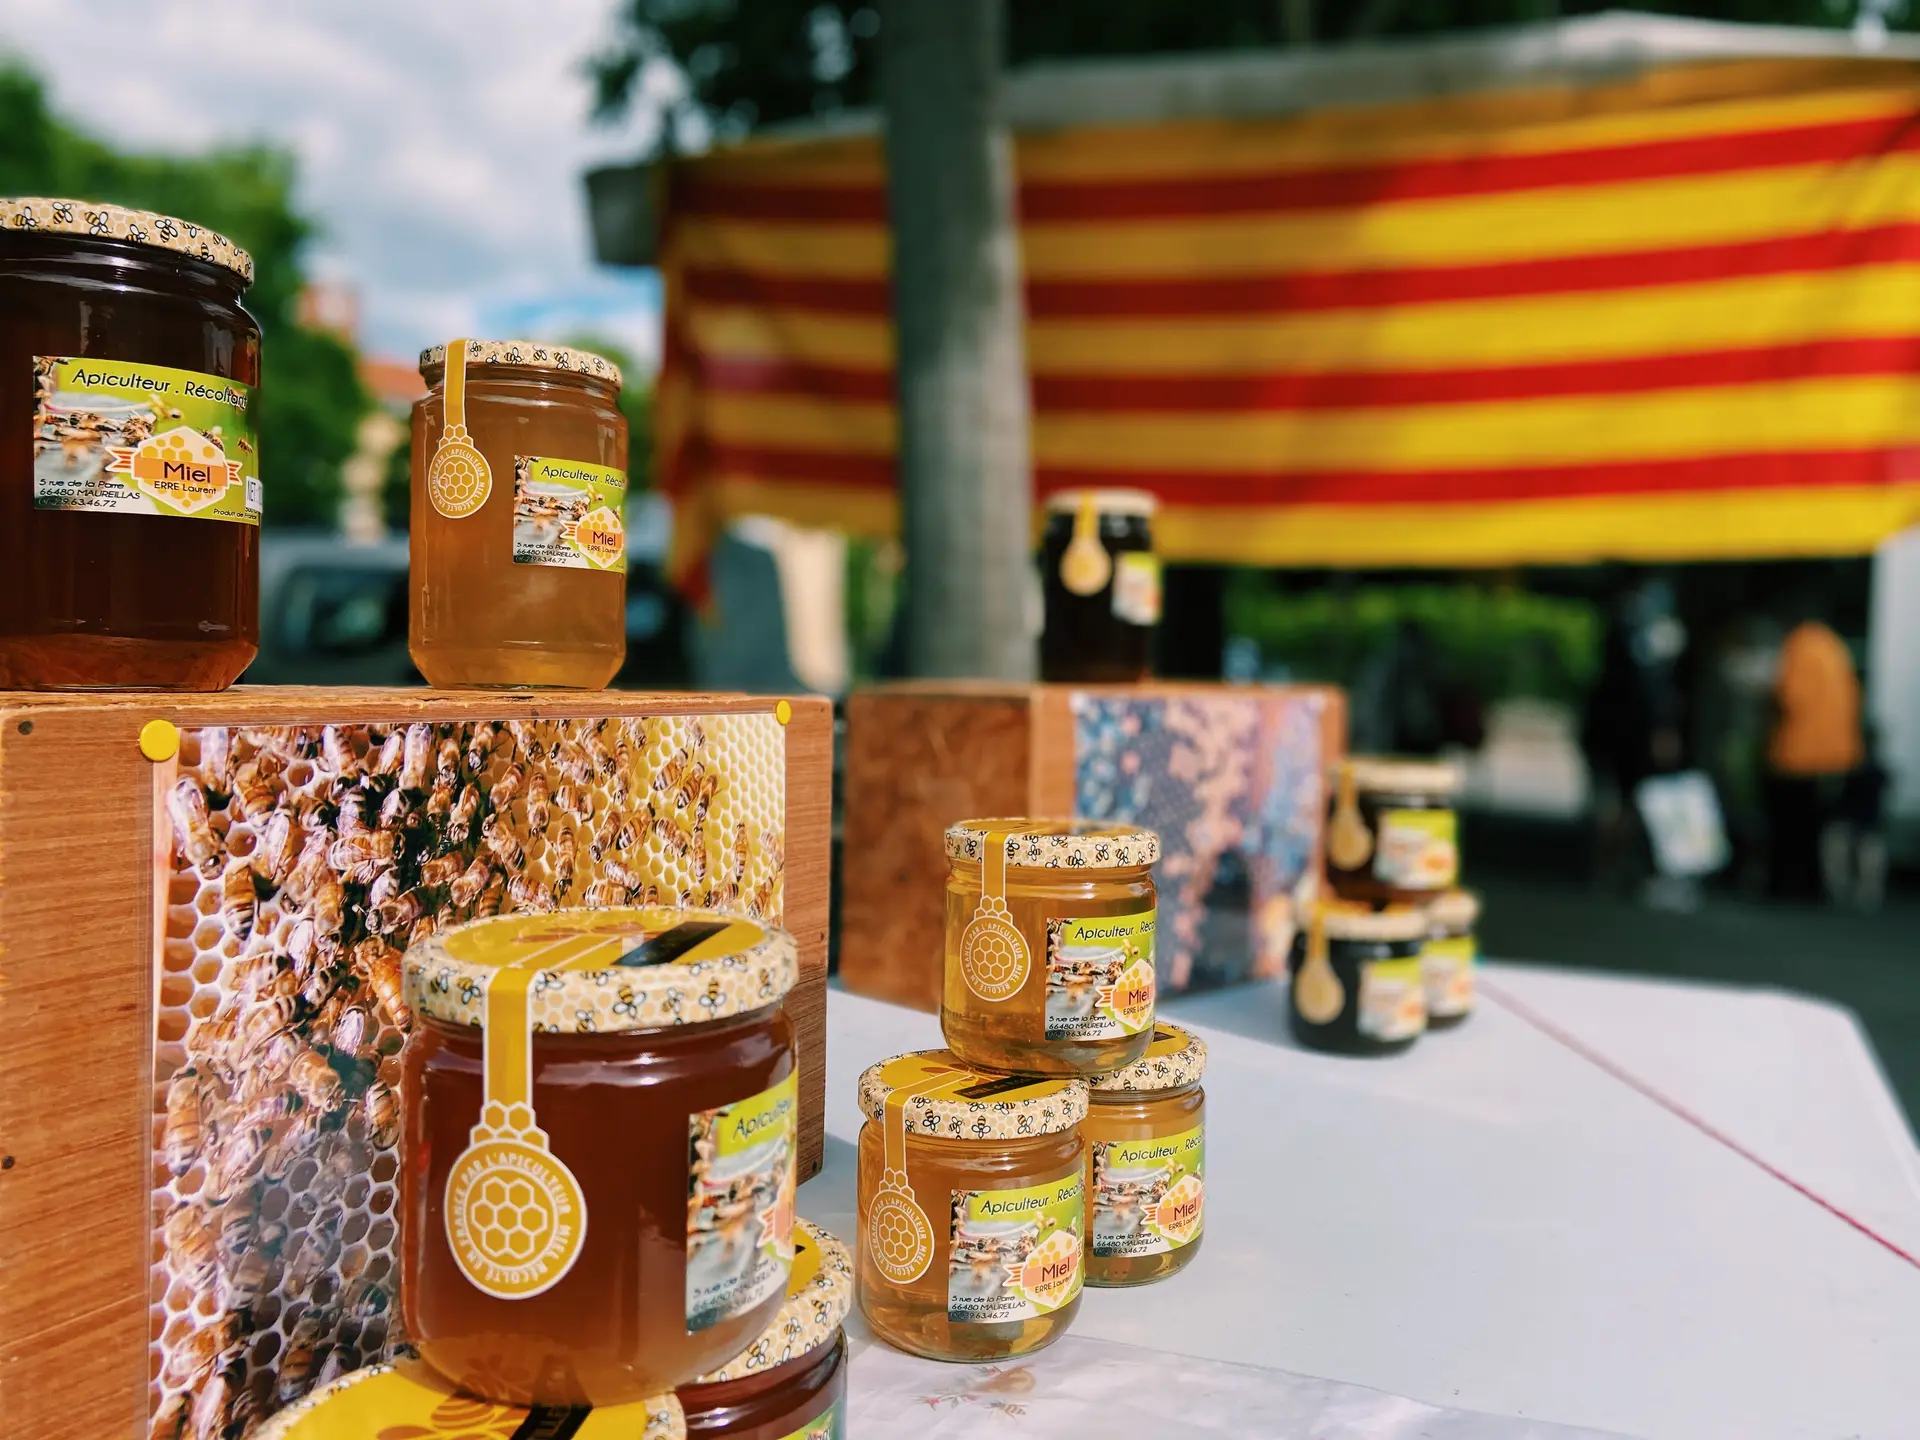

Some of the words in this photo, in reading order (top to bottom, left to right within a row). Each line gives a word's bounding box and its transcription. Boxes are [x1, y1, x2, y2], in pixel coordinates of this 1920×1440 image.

[72, 368, 171, 393] Apiculteur
[164, 461, 211, 483] Miel
[541, 465, 599, 482] Apiculteur
[39, 478, 47, 486] 5
[67, 479, 82, 487] de
[85, 480, 95, 488] la
[154, 480, 180, 491] ERRE
[182, 484, 217, 495] Laurent
[39, 488, 74, 496] 66480
[76, 489, 141, 500] MAUREILLAS
[592, 531, 616, 547] Miel
[969, 926, 980, 940] PAR
[981, 922, 1024, 959] L'APICULTEUR
[1074, 925, 1135, 941] Apiculteur
[1010, 964, 1024, 983] MIEL
[1128, 986, 1150, 1005] Miel
[1123, 1008, 1137, 1016] ERRE
[1119, 1145, 1179, 1163] Apiculteur
[460, 1159, 485, 1184] PAR
[485, 1152, 572, 1214] L'APICULTEUR
[980, 1196, 1049, 1216] Apiculteur
[1174, 1197, 1197, 1221] Miel
[453, 1187, 470, 1247] FRANCE
[885, 1197, 927, 1240] L'APICULTEUR
[1168, 1220, 1183, 1230] ERRE
[544, 1224, 572, 1260] MIEL
[466, 1249, 483, 1271] EN
[914, 1244, 927, 1265] MIEL
[1041, 1257, 1071, 1282] Miel
[1034, 1282, 1052, 1294] ERRE
[951, 1303, 979, 1311] 66480
[980, 1300, 1026, 1311] MAUREILLAS
